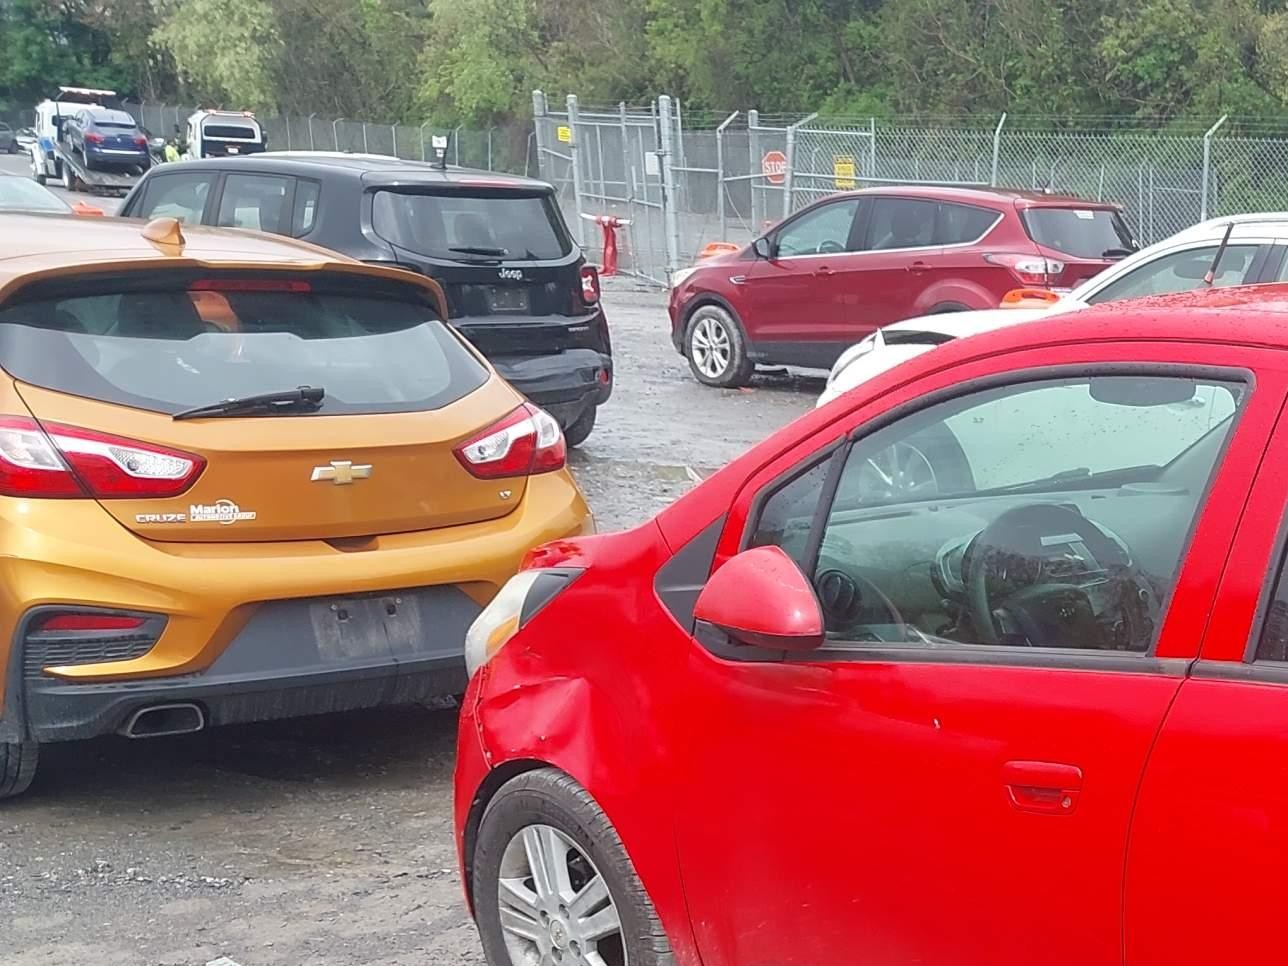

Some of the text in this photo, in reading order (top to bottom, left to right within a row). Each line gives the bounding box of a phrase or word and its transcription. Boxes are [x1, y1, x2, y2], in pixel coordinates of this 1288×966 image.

[499, 268, 522, 280] Jeep
[190, 503, 239, 515] Marion
[135, 513, 186, 523] CRUZE
